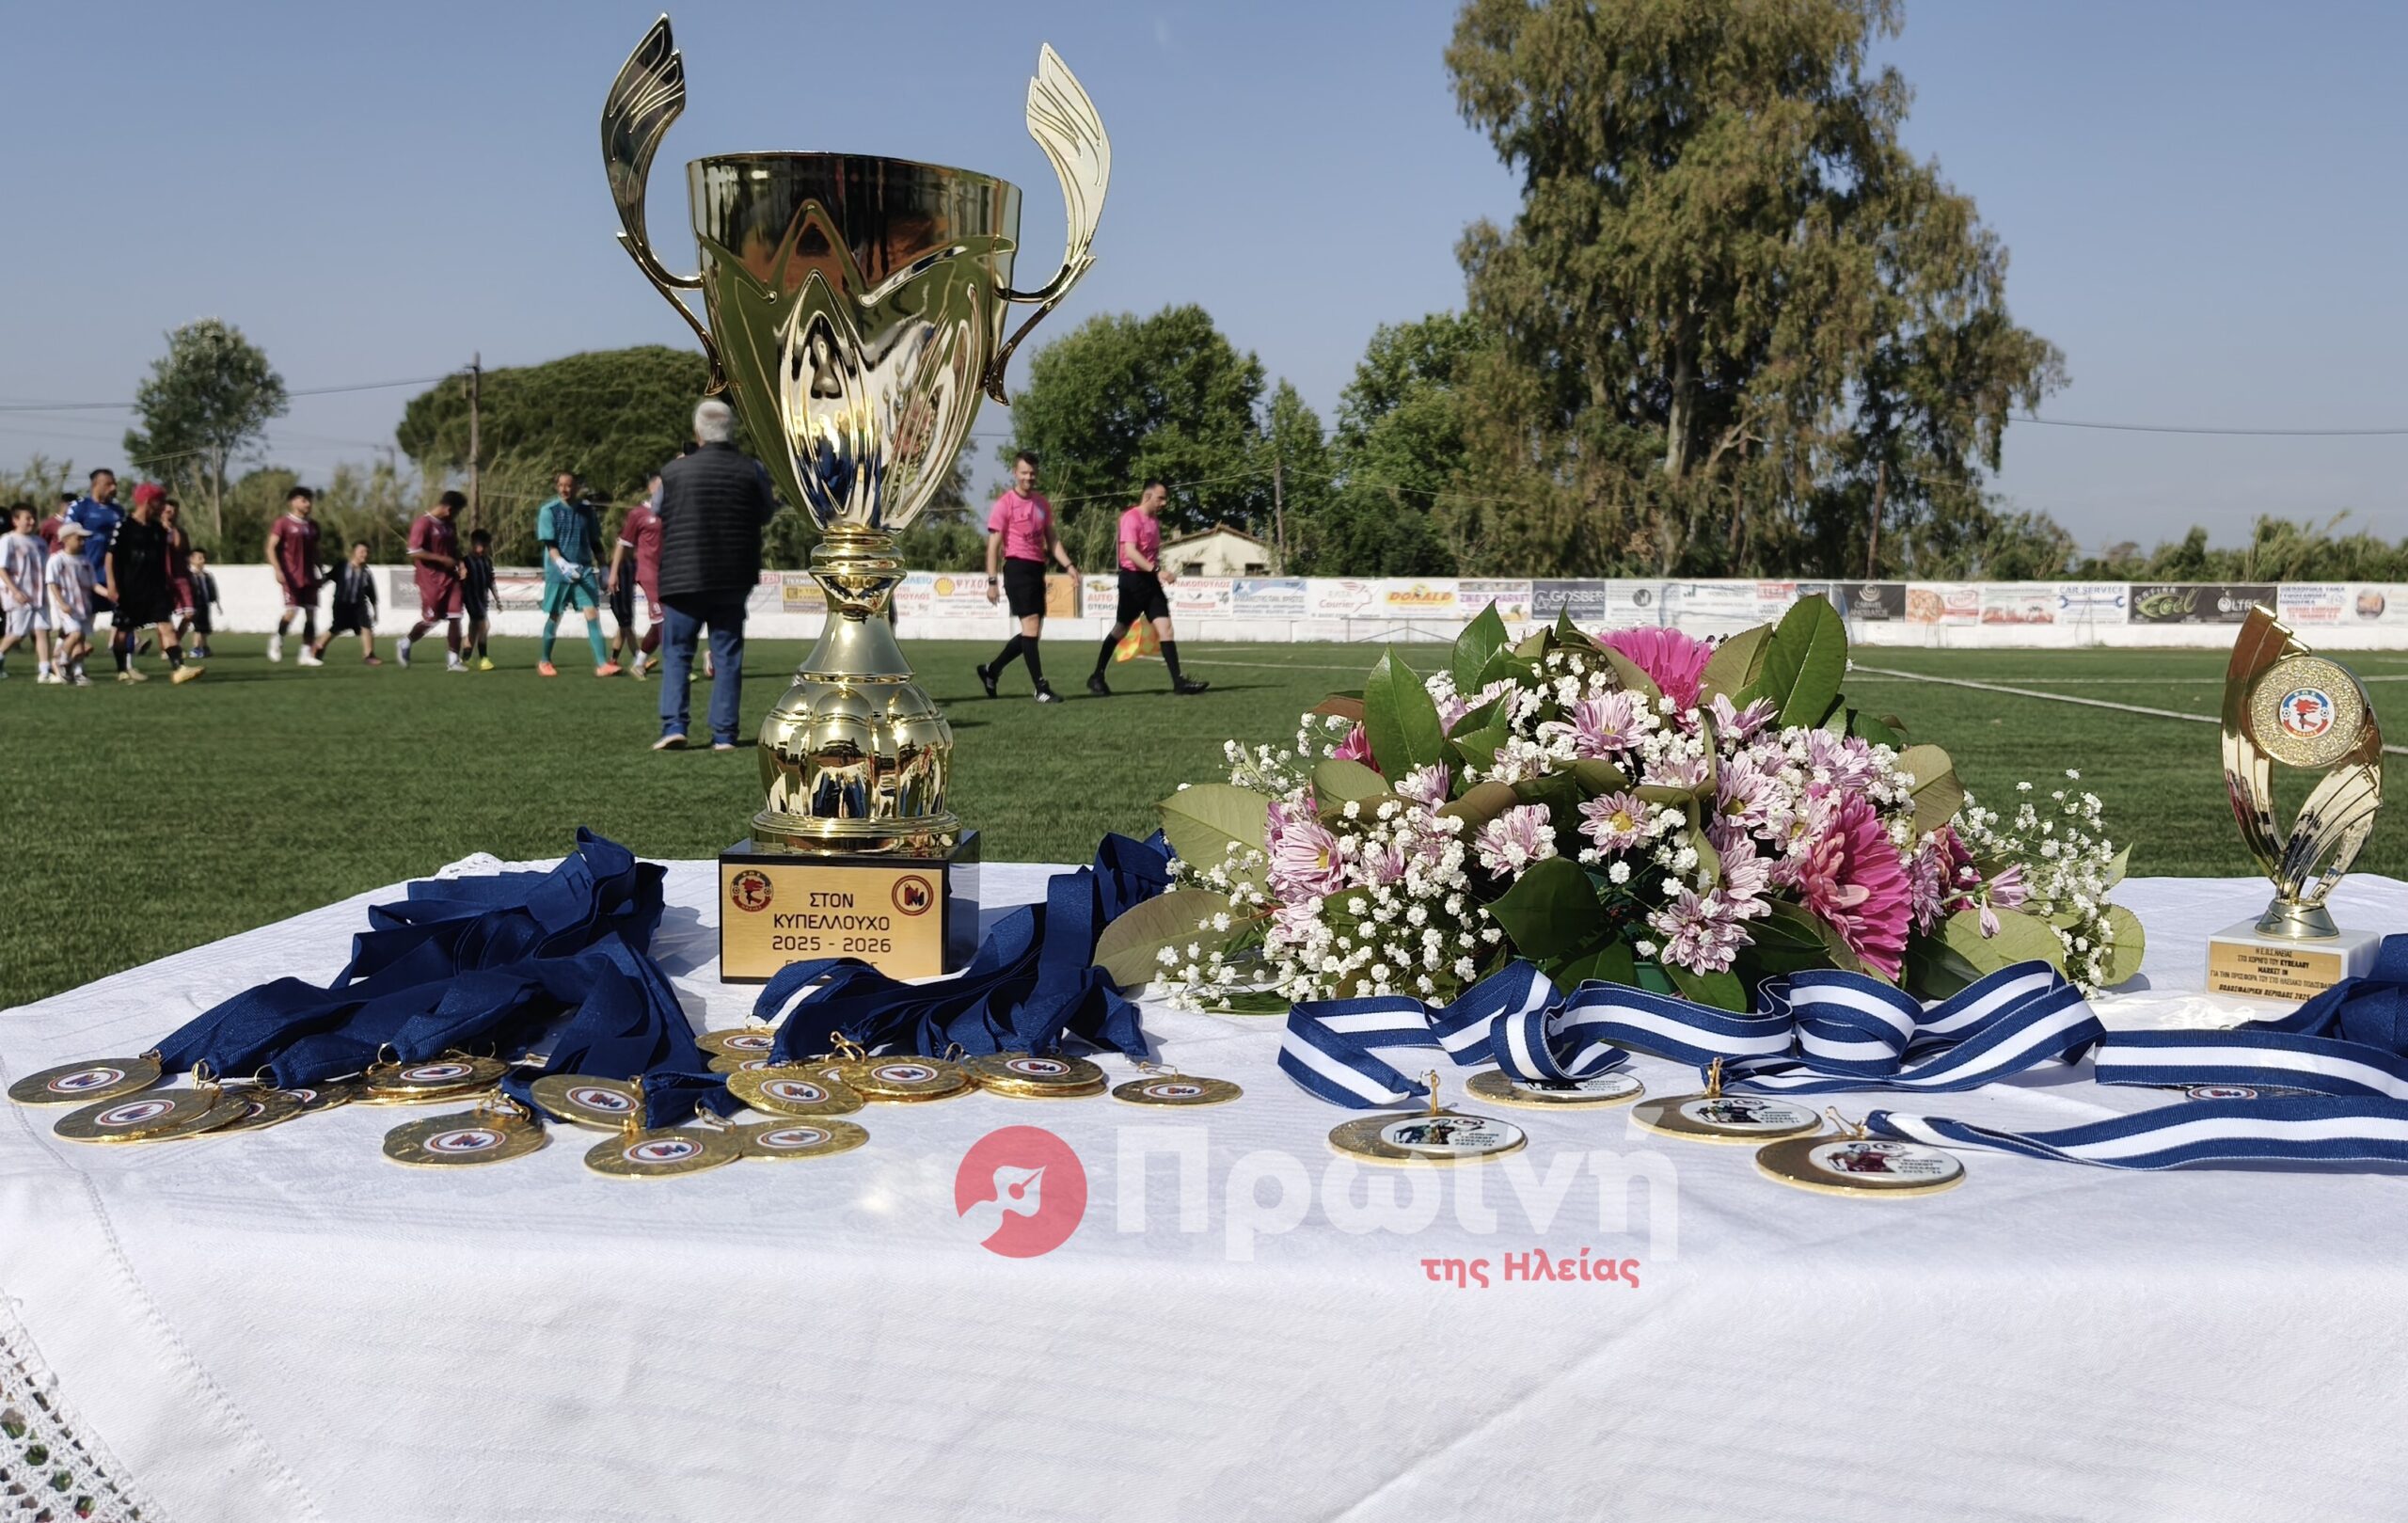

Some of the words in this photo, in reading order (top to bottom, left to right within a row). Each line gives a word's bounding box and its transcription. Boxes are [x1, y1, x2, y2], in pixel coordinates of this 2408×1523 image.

[2083, 586, 2125, 595] SERVICE
[1087, 594, 1114, 602] AUTO
[1388, 592, 1453, 601] DONALD
[1496, 594, 1530, 603] MARKET
[1319, 599, 1355, 608] Courier
[809, 893, 854, 909] ΣΤΟΝ
[773, 913, 890, 931] ΚΥΠΕΛΛΟΥΧΟ
[772, 935, 821, 951] 2025
[843, 938, 892, 953] 2026
[2258, 966, 2280, 975] MARKET
